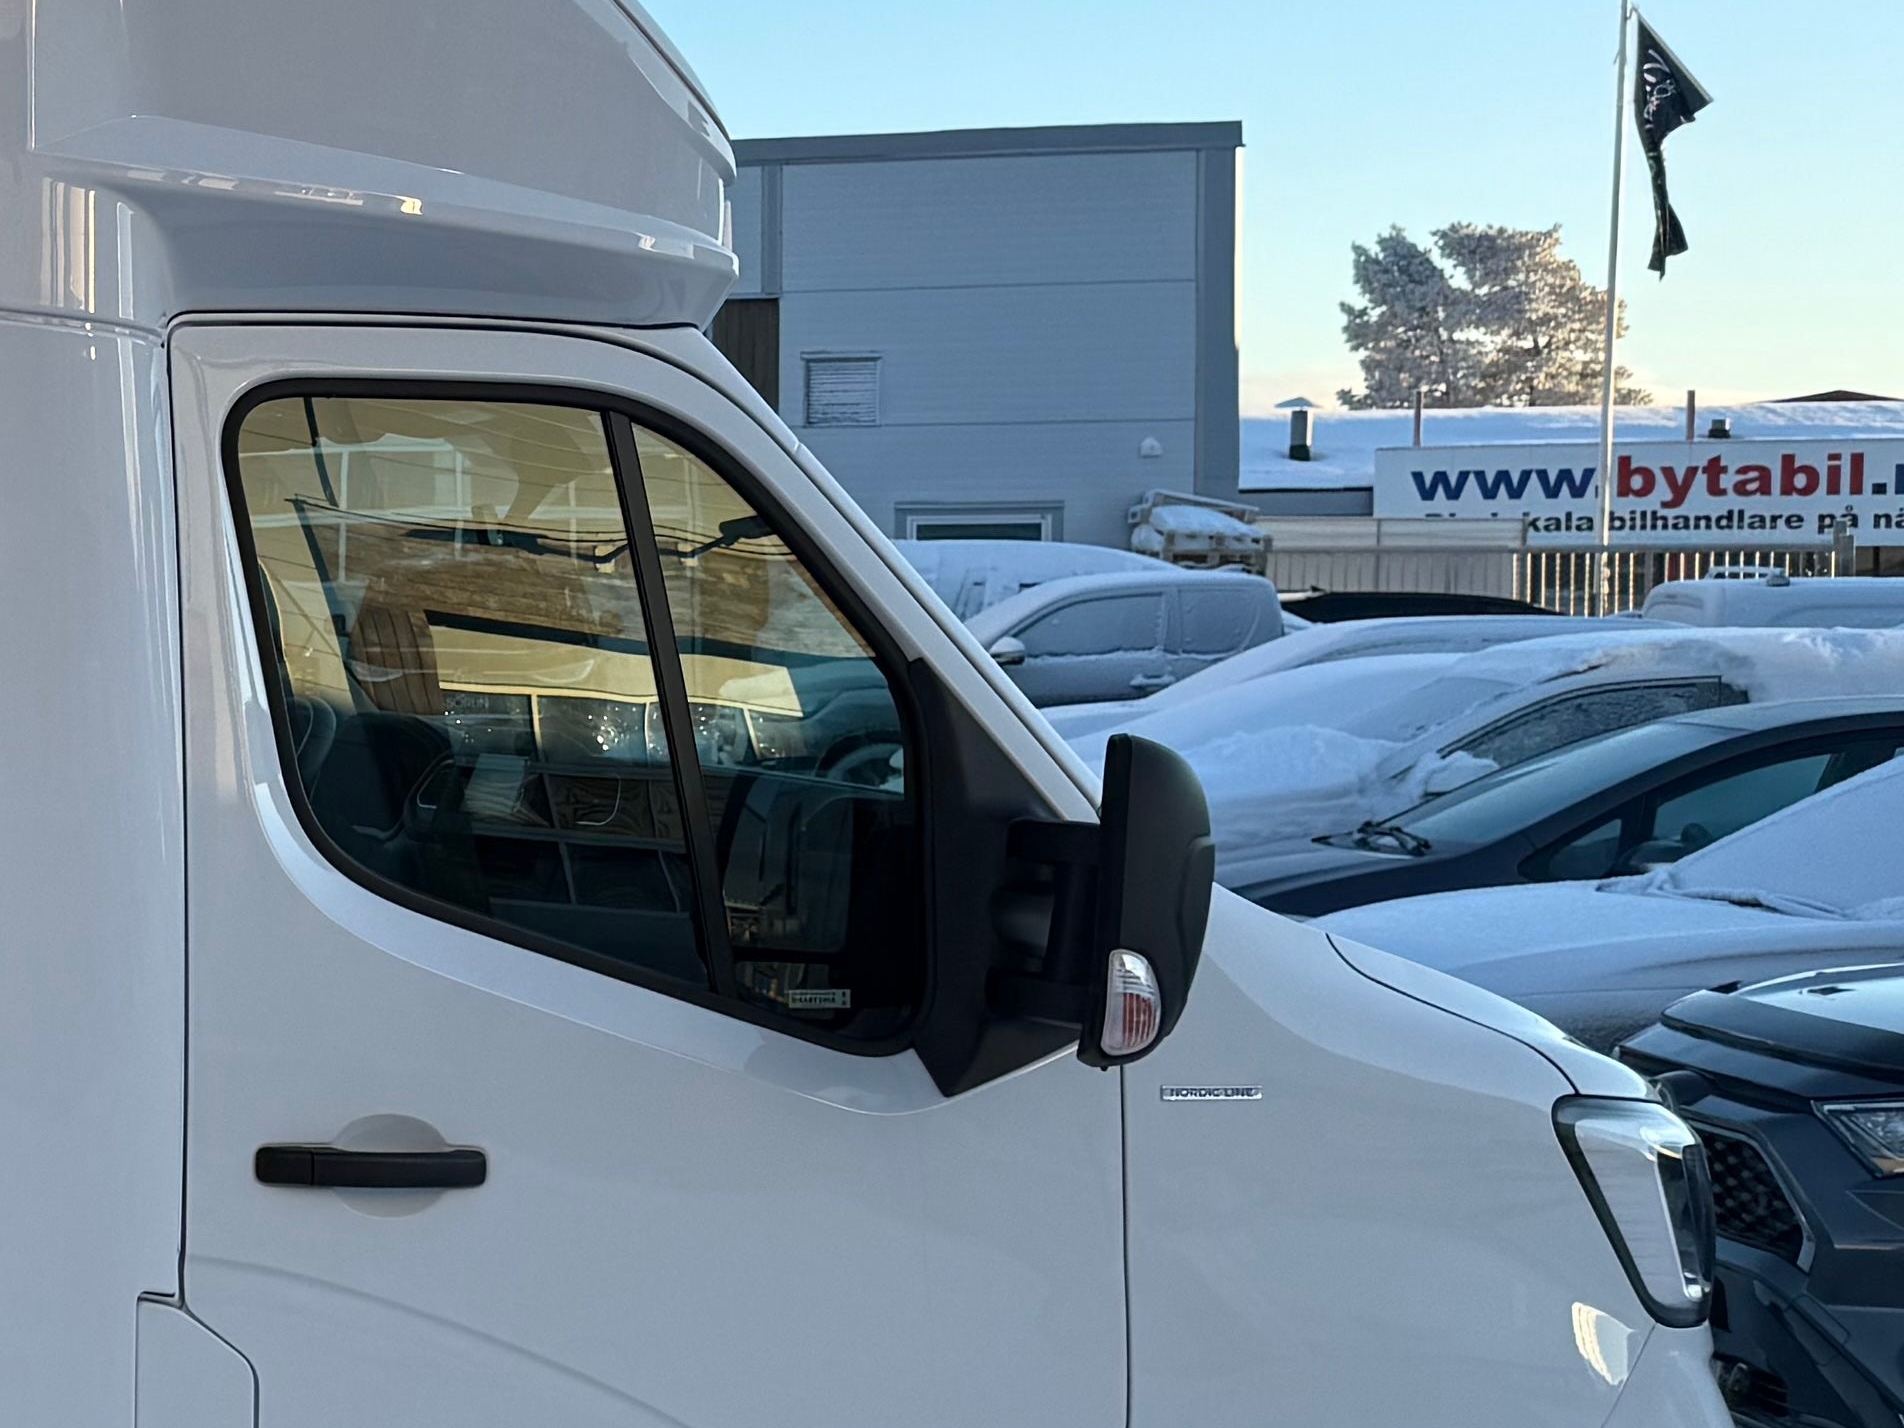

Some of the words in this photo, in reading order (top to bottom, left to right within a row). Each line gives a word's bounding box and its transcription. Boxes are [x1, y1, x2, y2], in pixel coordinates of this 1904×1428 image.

[1411, 451, 1904, 509] wwwbytabil.
[1608, 509, 1804, 531] bilhandlare
[1818, 504, 1859, 535] på
[1170, 1087, 1221, 1097] NORDIC
